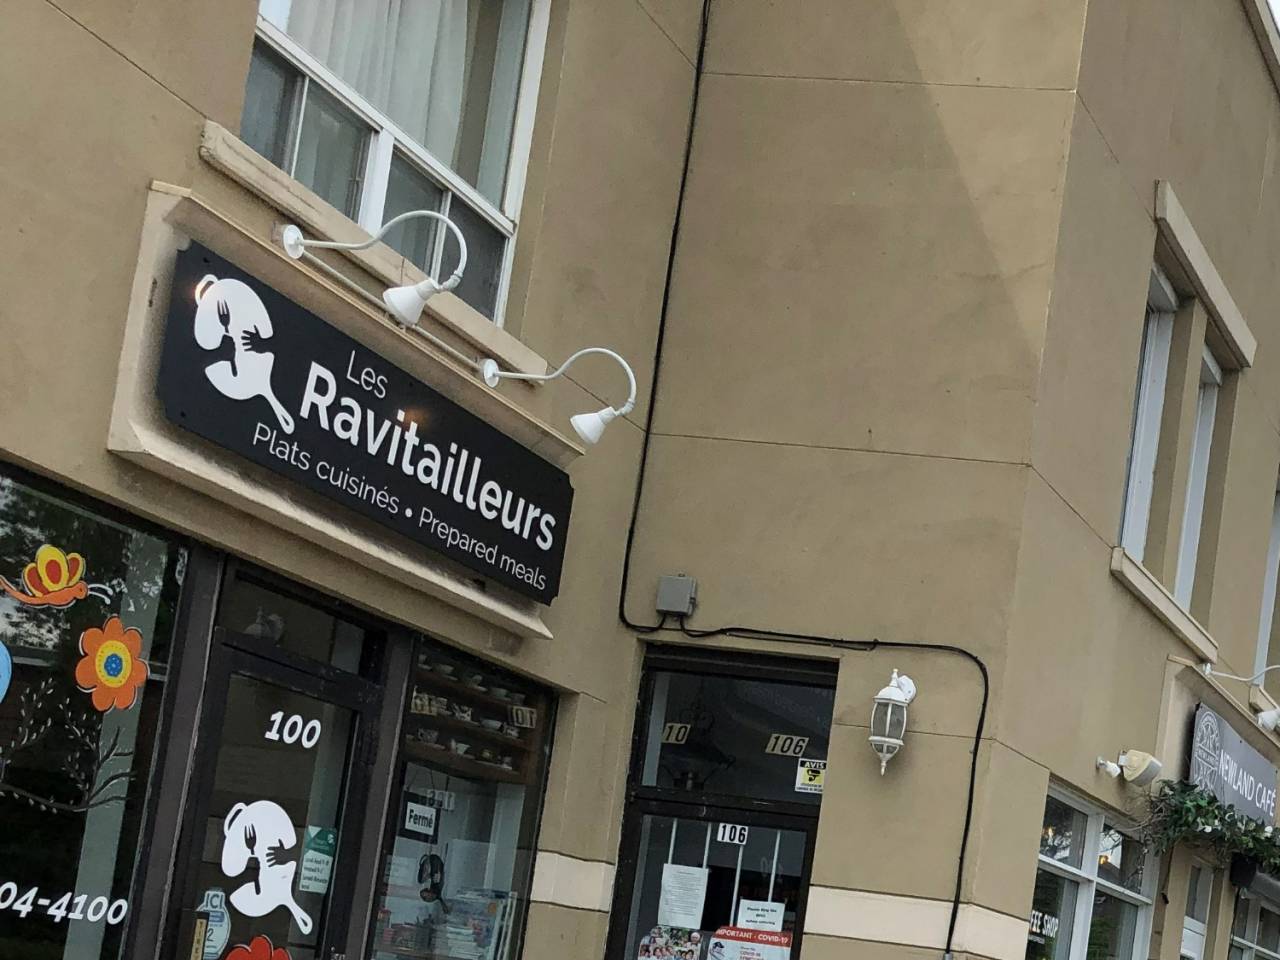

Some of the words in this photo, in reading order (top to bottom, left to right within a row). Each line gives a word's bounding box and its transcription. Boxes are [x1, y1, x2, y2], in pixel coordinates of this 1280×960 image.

[346, 350, 388, 399] Les
[253, 422, 310, 471] Plats
[316, 458, 400, 515] cuisinés
[300, 361, 557, 551] Ravitailleurs
[418, 507, 497, 566] Prepared
[499, 555, 547, 591] meals
[264, 711, 321, 749] 100
[772, 735, 805, 755] 106
[804, 761, 824, 769] AVIS
[1219, 749, 1255, 801] NEWLAND
[1255, 782, 1277, 817] CAFÉ
[408, 808, 434, 829] Fermé
[721, 824, 747, 844] 106
[204, 892, 225, 909] ICI
